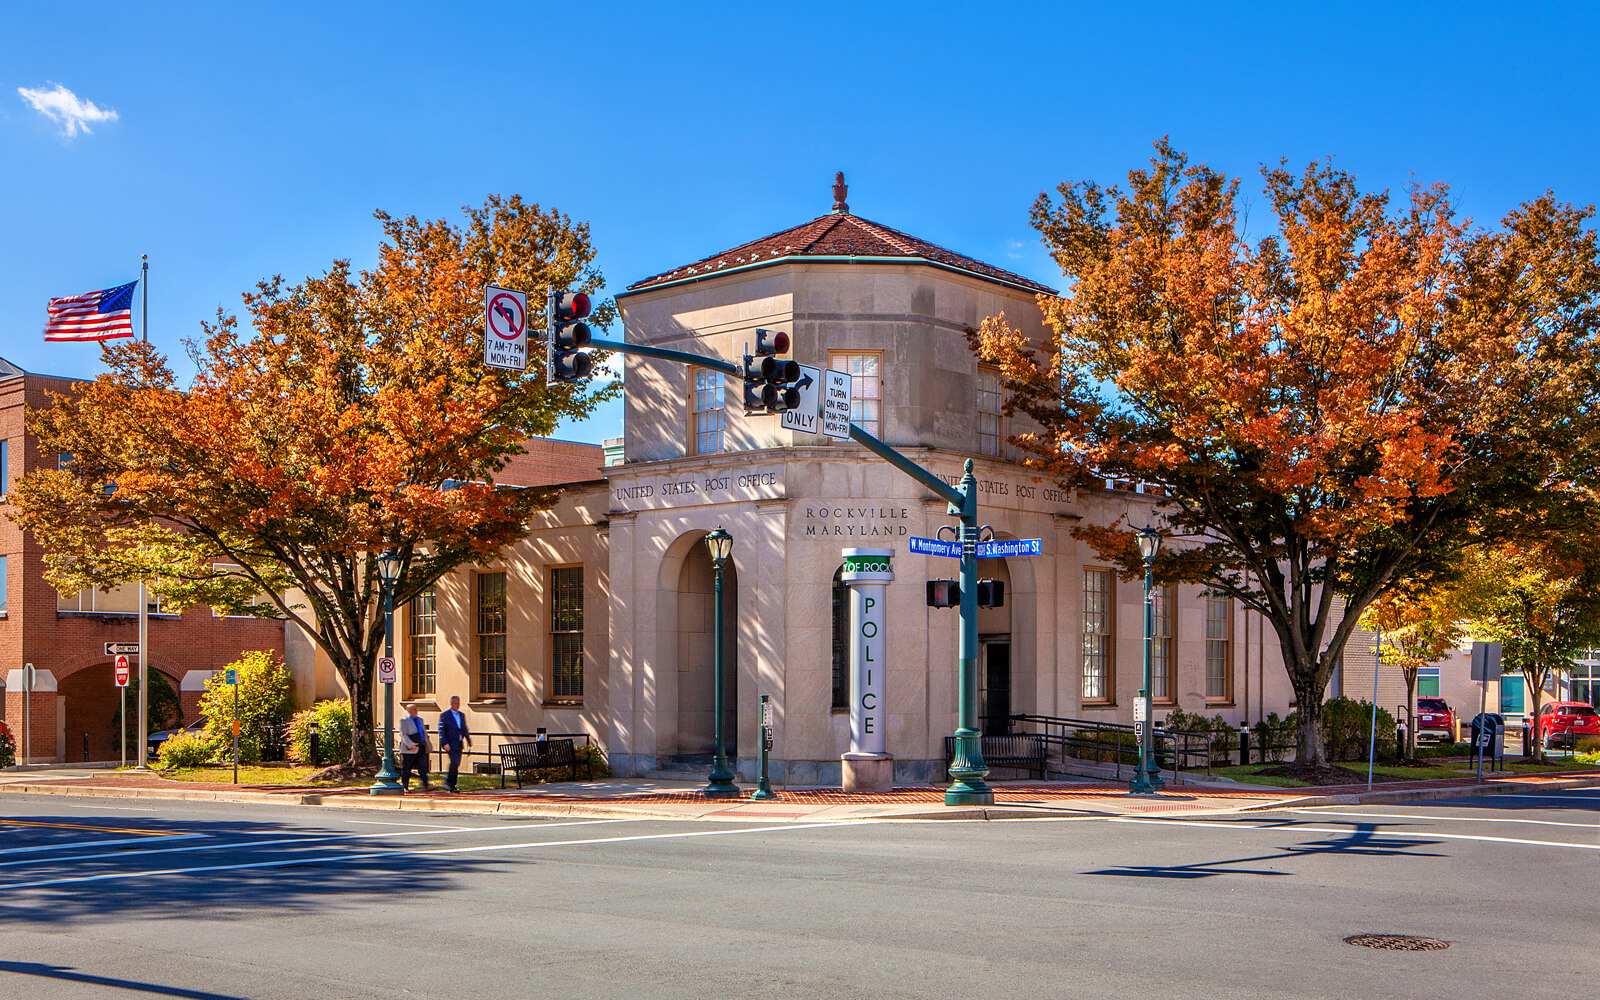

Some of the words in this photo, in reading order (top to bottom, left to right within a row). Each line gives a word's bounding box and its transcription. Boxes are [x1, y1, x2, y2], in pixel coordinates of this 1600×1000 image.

[488, 339, 492, 349] 7
[494, 340, 512, 352] AM-7
[514, 343, 524, 354] PM
[490, 352, 520, 366] MON-FRI
[833, 376, 843, 386] NO
[830, 387, 847, 399] TURN
[826, 399, 835, 409] ON
[836, 401, 849, 412] RED
[786, 410, 814, 428] ONLY
[825, 421, 848, 434] MON-FRI
[616, 485, 654, 500] UNITED
[661, 480, 696, 496] STATES
[705, 477, 730, 491] POST
[738, 472, 776, 488] OFFICE
[979, 480, 1009, 495] STATES
[1015, 484, 1037, 499] POST
[1043, 488, 1072, 503] OFFICE
[806, 507, 909, 519] ROCKVILLE
[806, 525, 908, 536] MARYLAND
[910, 538, 918, 551] W.
[918, 538, 951, 557] Montgomery
[951, 543, 962, 556] Ave
[1031, 540, 1040, 553] St
[861, 597, 878, 734] POLICE
